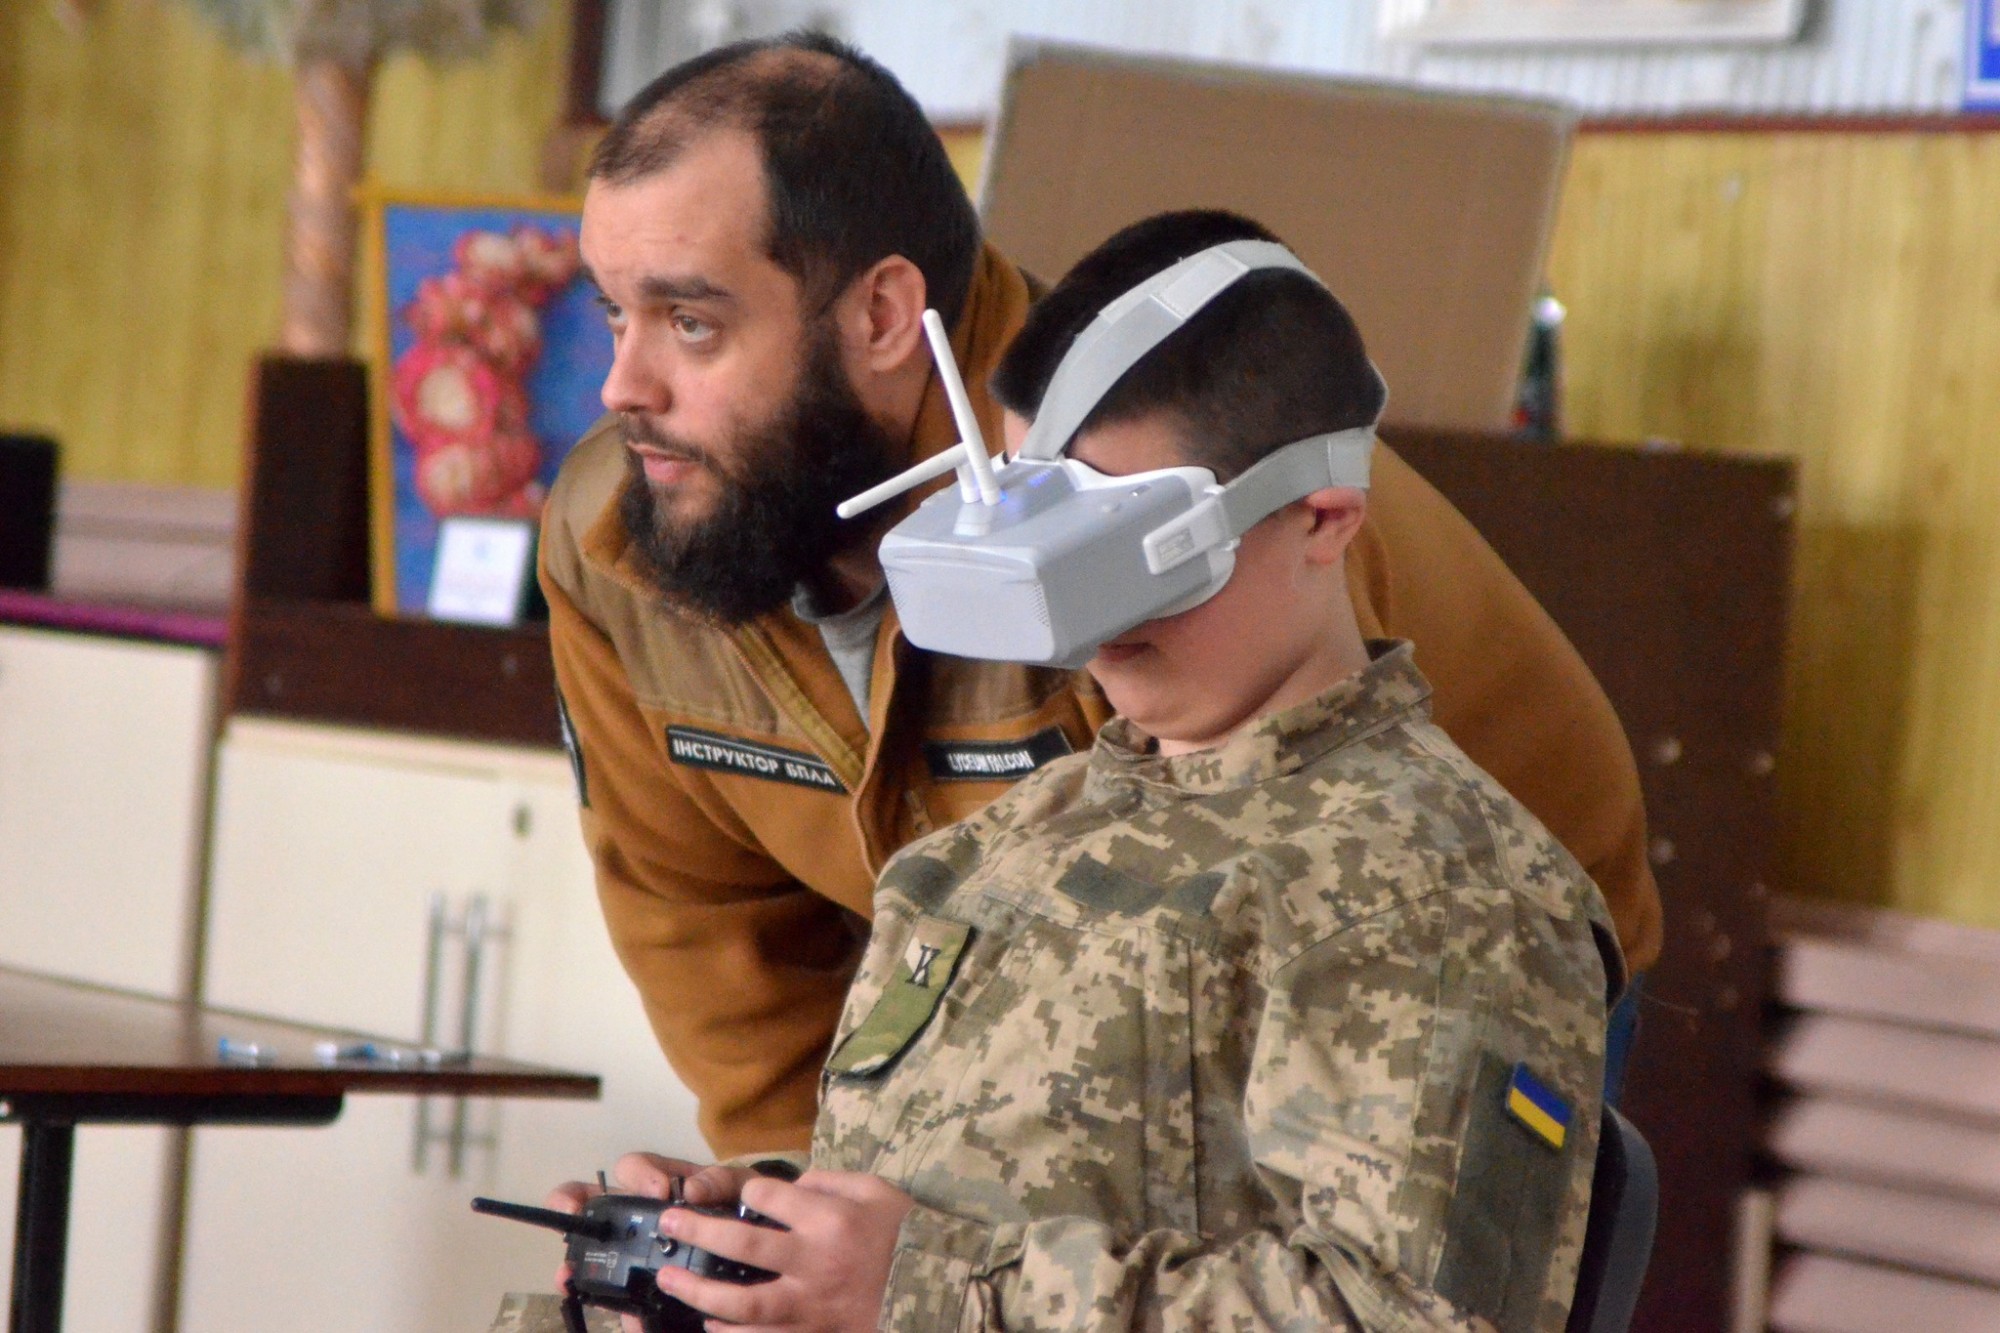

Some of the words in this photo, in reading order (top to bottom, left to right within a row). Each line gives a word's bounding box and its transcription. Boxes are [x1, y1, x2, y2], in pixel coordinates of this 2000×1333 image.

[672, 739, 779, 774] ІНСТРУКТОР
[785, 763, 836, 786] БПЛА
[987, 750, 1035, 773] FALCON
